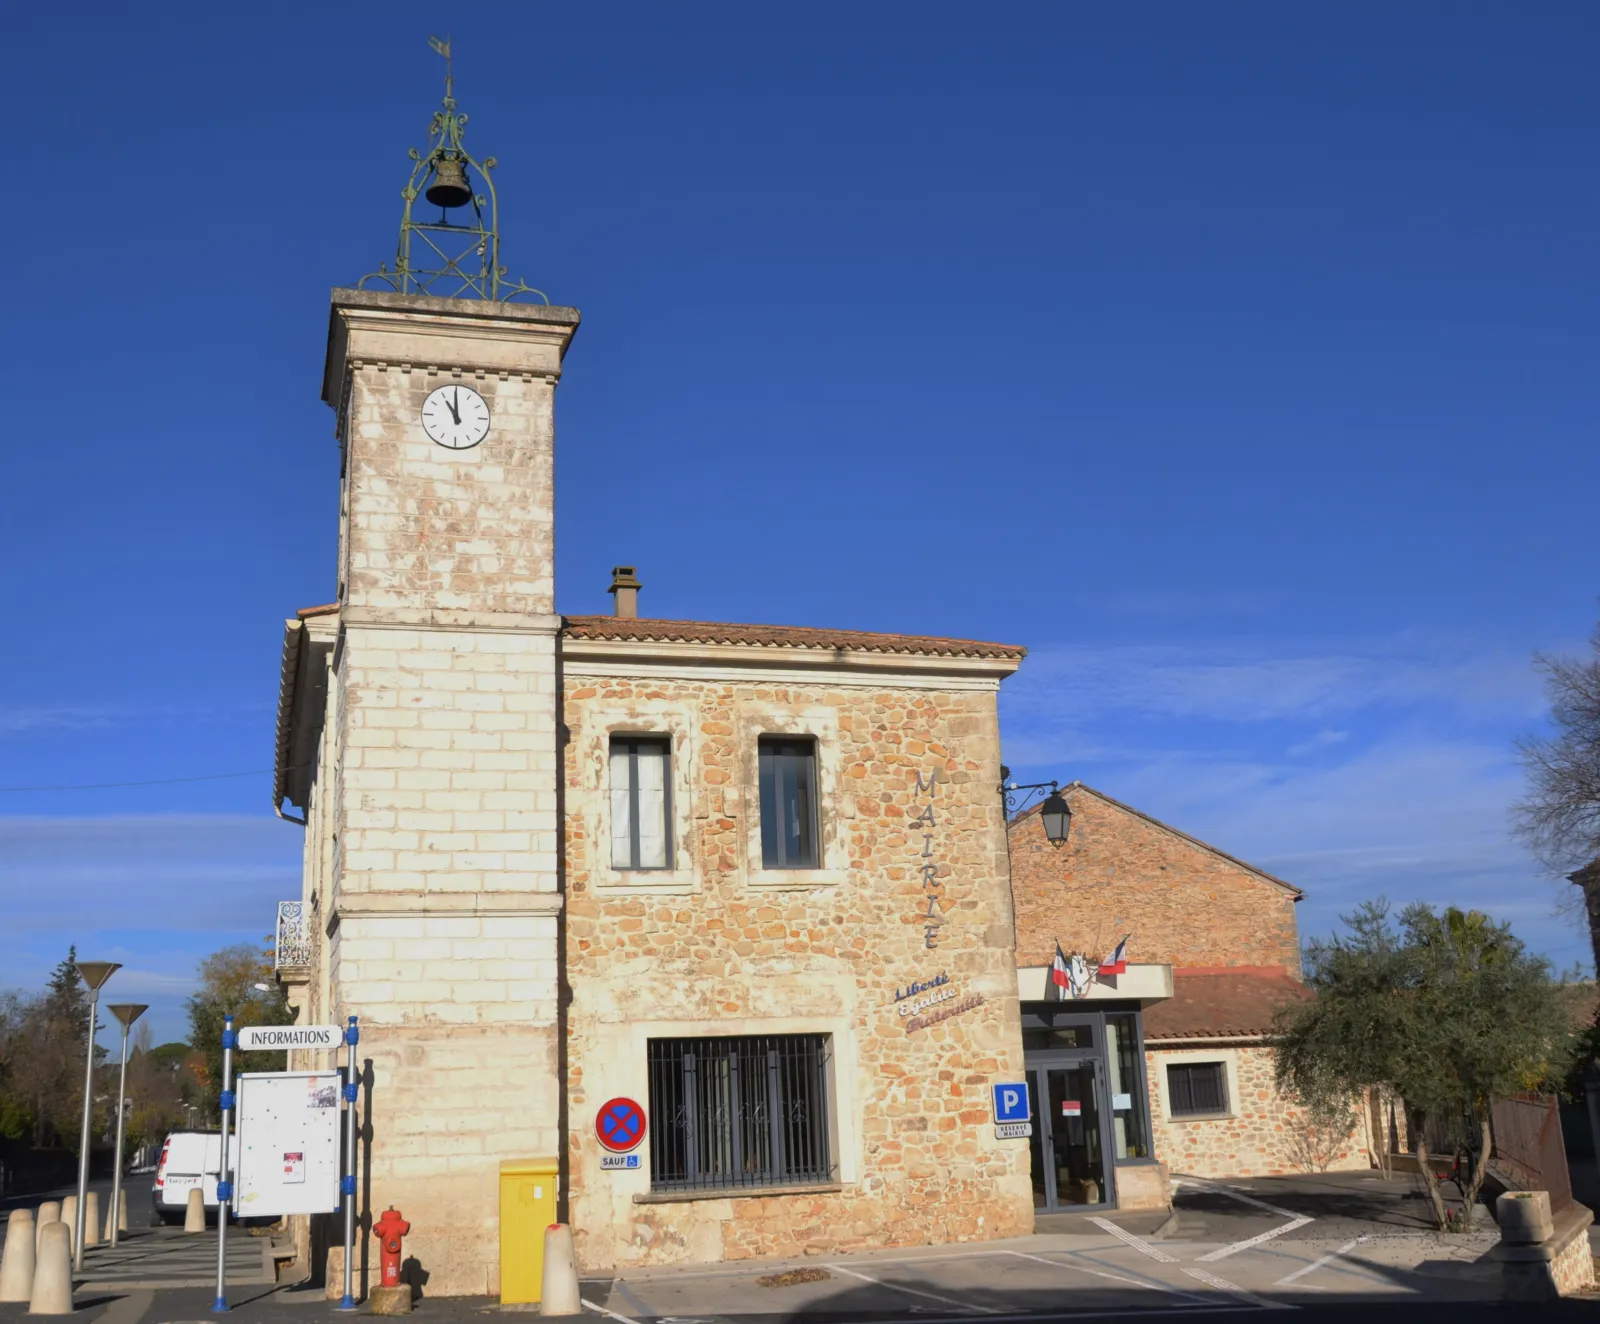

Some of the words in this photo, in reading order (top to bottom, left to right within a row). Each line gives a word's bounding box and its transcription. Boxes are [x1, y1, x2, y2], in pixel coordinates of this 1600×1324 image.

[914, 771, 940, 949] MAIRIE
[895, 969, 949, 1003] Liberté
[251, 1030, 330, 1045] INFORMATIONS
[1003, 1090, 1019, 1114] P
[602, 1157, 625, 1166] SAUF
